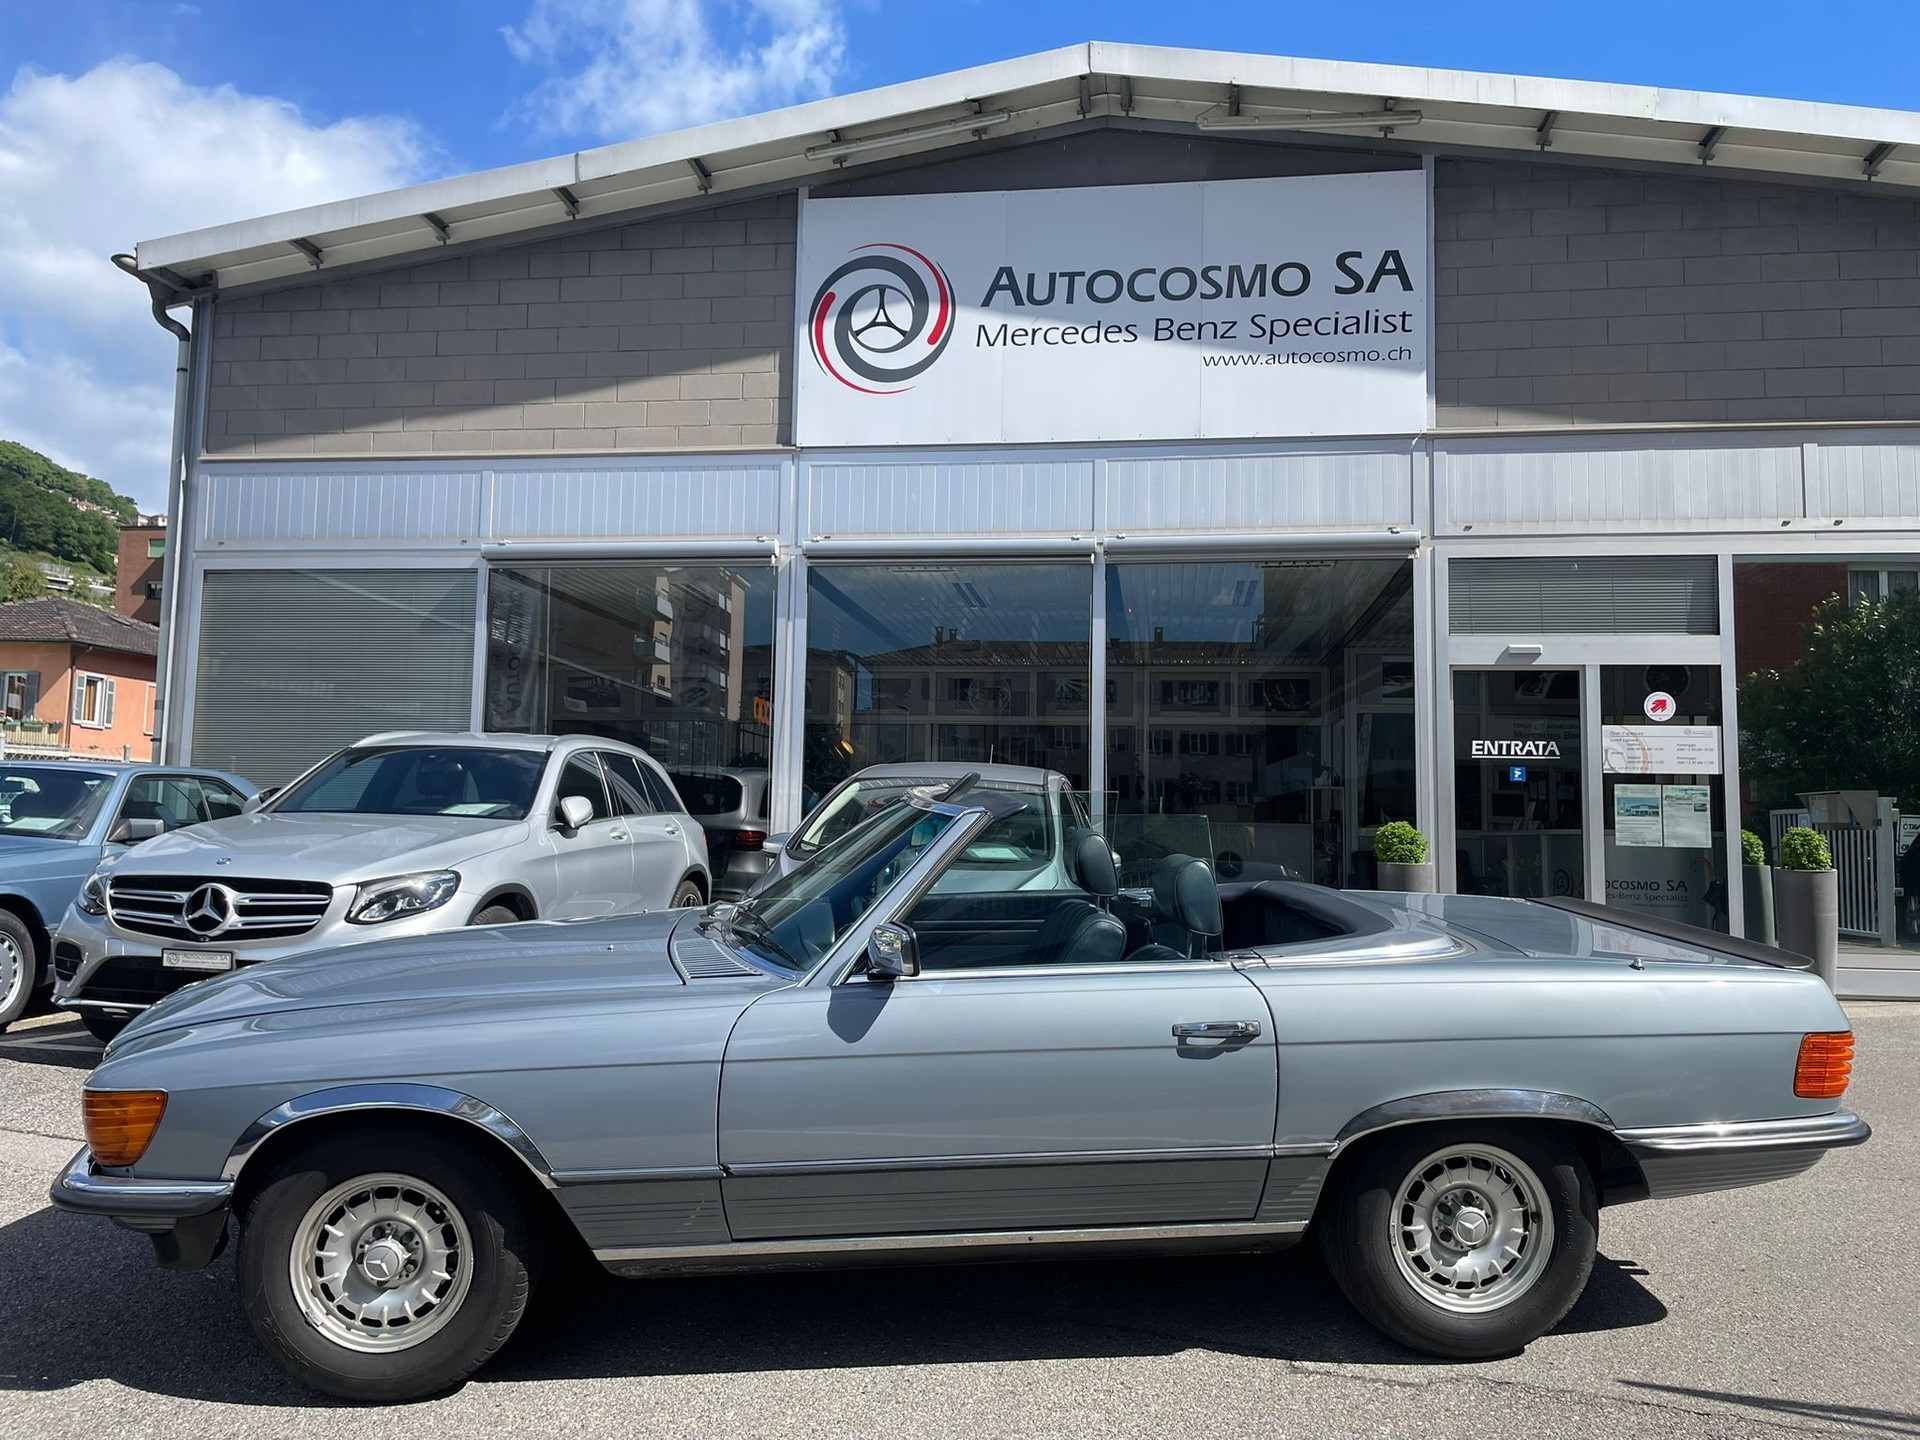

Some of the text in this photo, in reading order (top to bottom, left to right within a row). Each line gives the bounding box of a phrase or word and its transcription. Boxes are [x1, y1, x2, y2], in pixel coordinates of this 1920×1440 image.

[1334, 249, 1414, 295] SA
[976, 308, 1413, 347] Mercedes Benz Specialist
[1202, 346, 1412, 367] www.autocosmo.ch
[1471, 740, 1561, 755] ENTRATA
[1666, 879, 1688, 892] SA
[1643, 892, 1688, 902] Specialist
